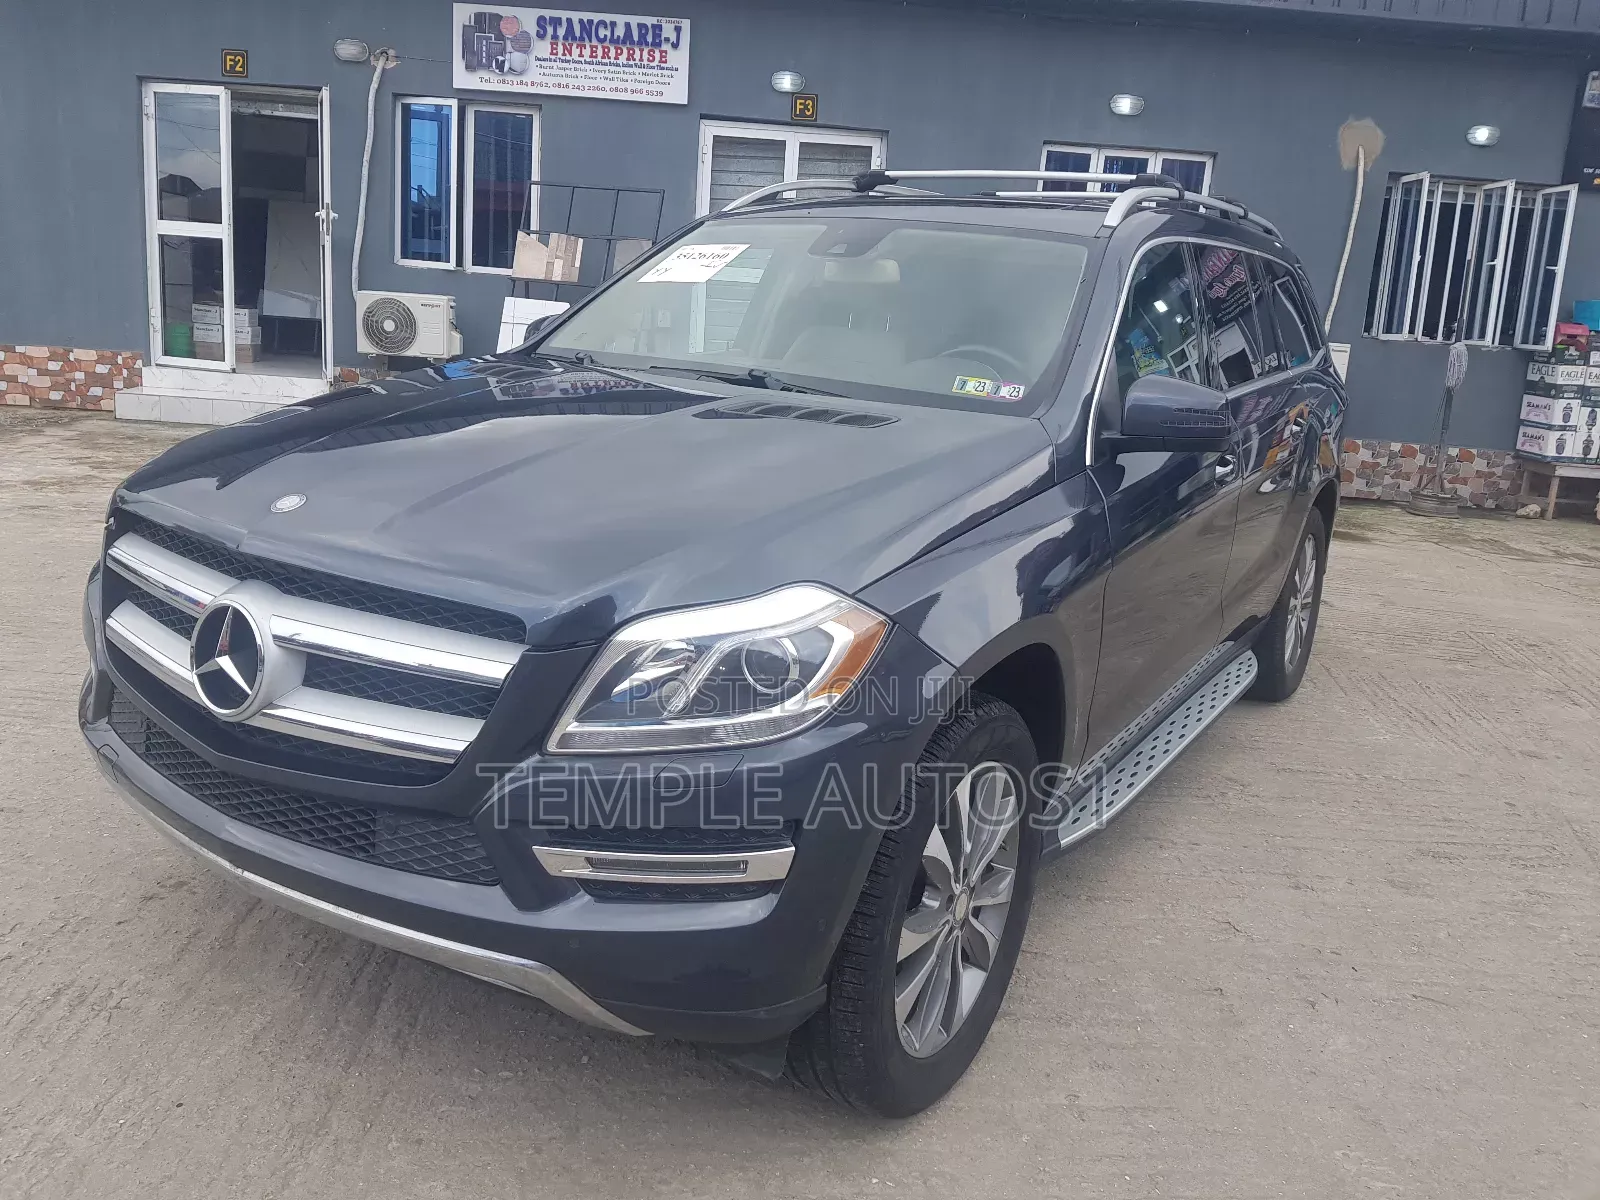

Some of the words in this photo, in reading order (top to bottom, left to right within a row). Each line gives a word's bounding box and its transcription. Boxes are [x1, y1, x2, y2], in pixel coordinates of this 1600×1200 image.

[536, 15, 682, 50] STANCLARE-J
[549, 41, 668, 64] ENTERPRISE
[226, 55, 243, 71] F2
[496, 78, 514, 86] 0813
[515, 79, 528, 87] 184
[530, 80, 551, 88] 8762,
[587, 85, 608, 93] 2260,
[645, 89, 664, 97] 5539
[796, 99, 813, 115] F3
[1531, 364, 1556, 377] EAGLE
[1561, 370, 1584, 379] EAGLE
[960, 380, 966, 391] 7
[975, 381, 986, 393] 23
[1009, 386, 1021, 398] 23
